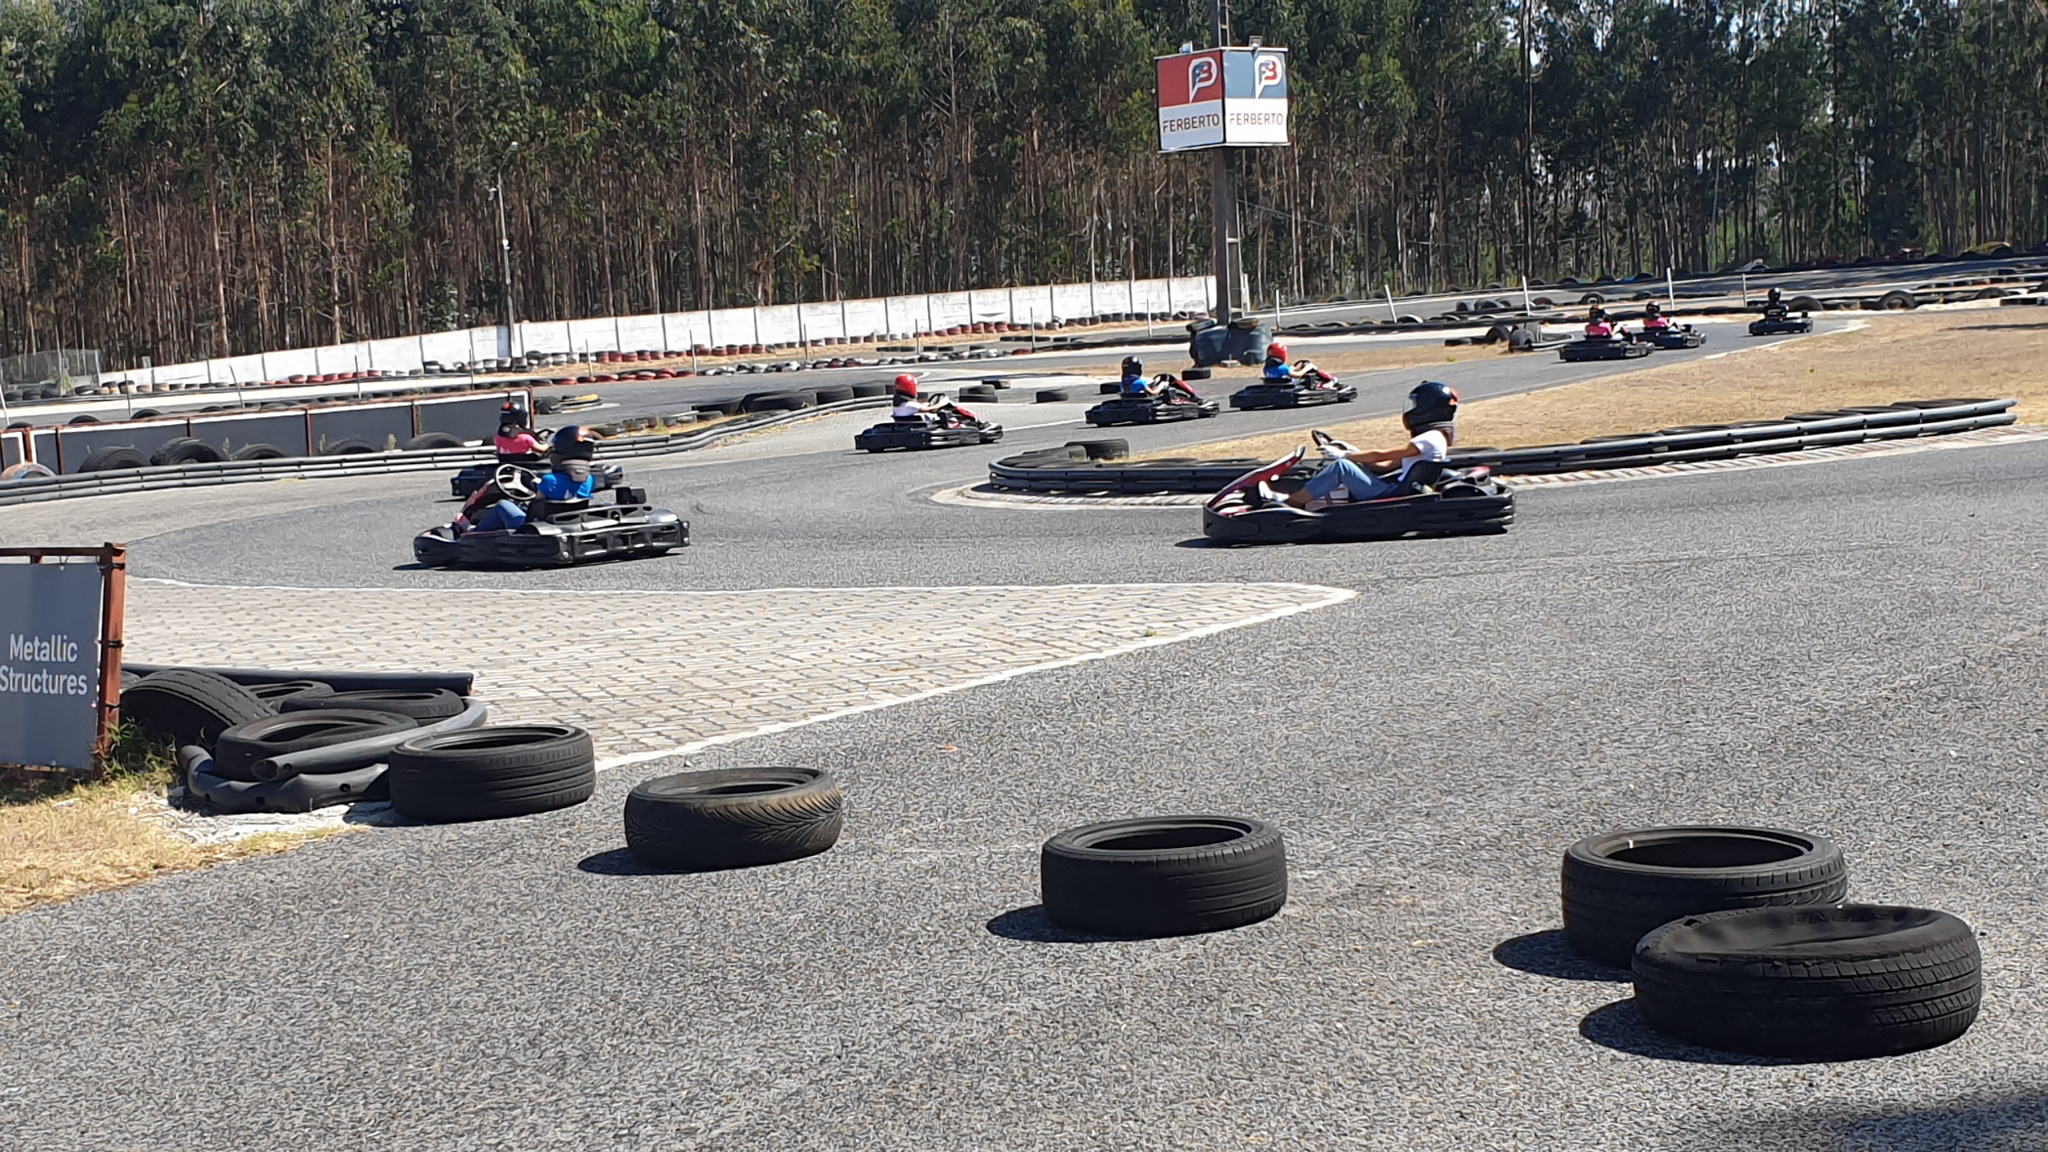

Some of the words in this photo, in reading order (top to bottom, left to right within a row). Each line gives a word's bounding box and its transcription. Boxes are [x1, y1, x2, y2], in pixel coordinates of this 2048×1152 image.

[1163, 113, 1220, 133] FERBERTO
[1230, 113, 1284, 126] FERBERTO
[9, 633, 78, 662] Metallic
[0, 665, 88, 696] Structures
